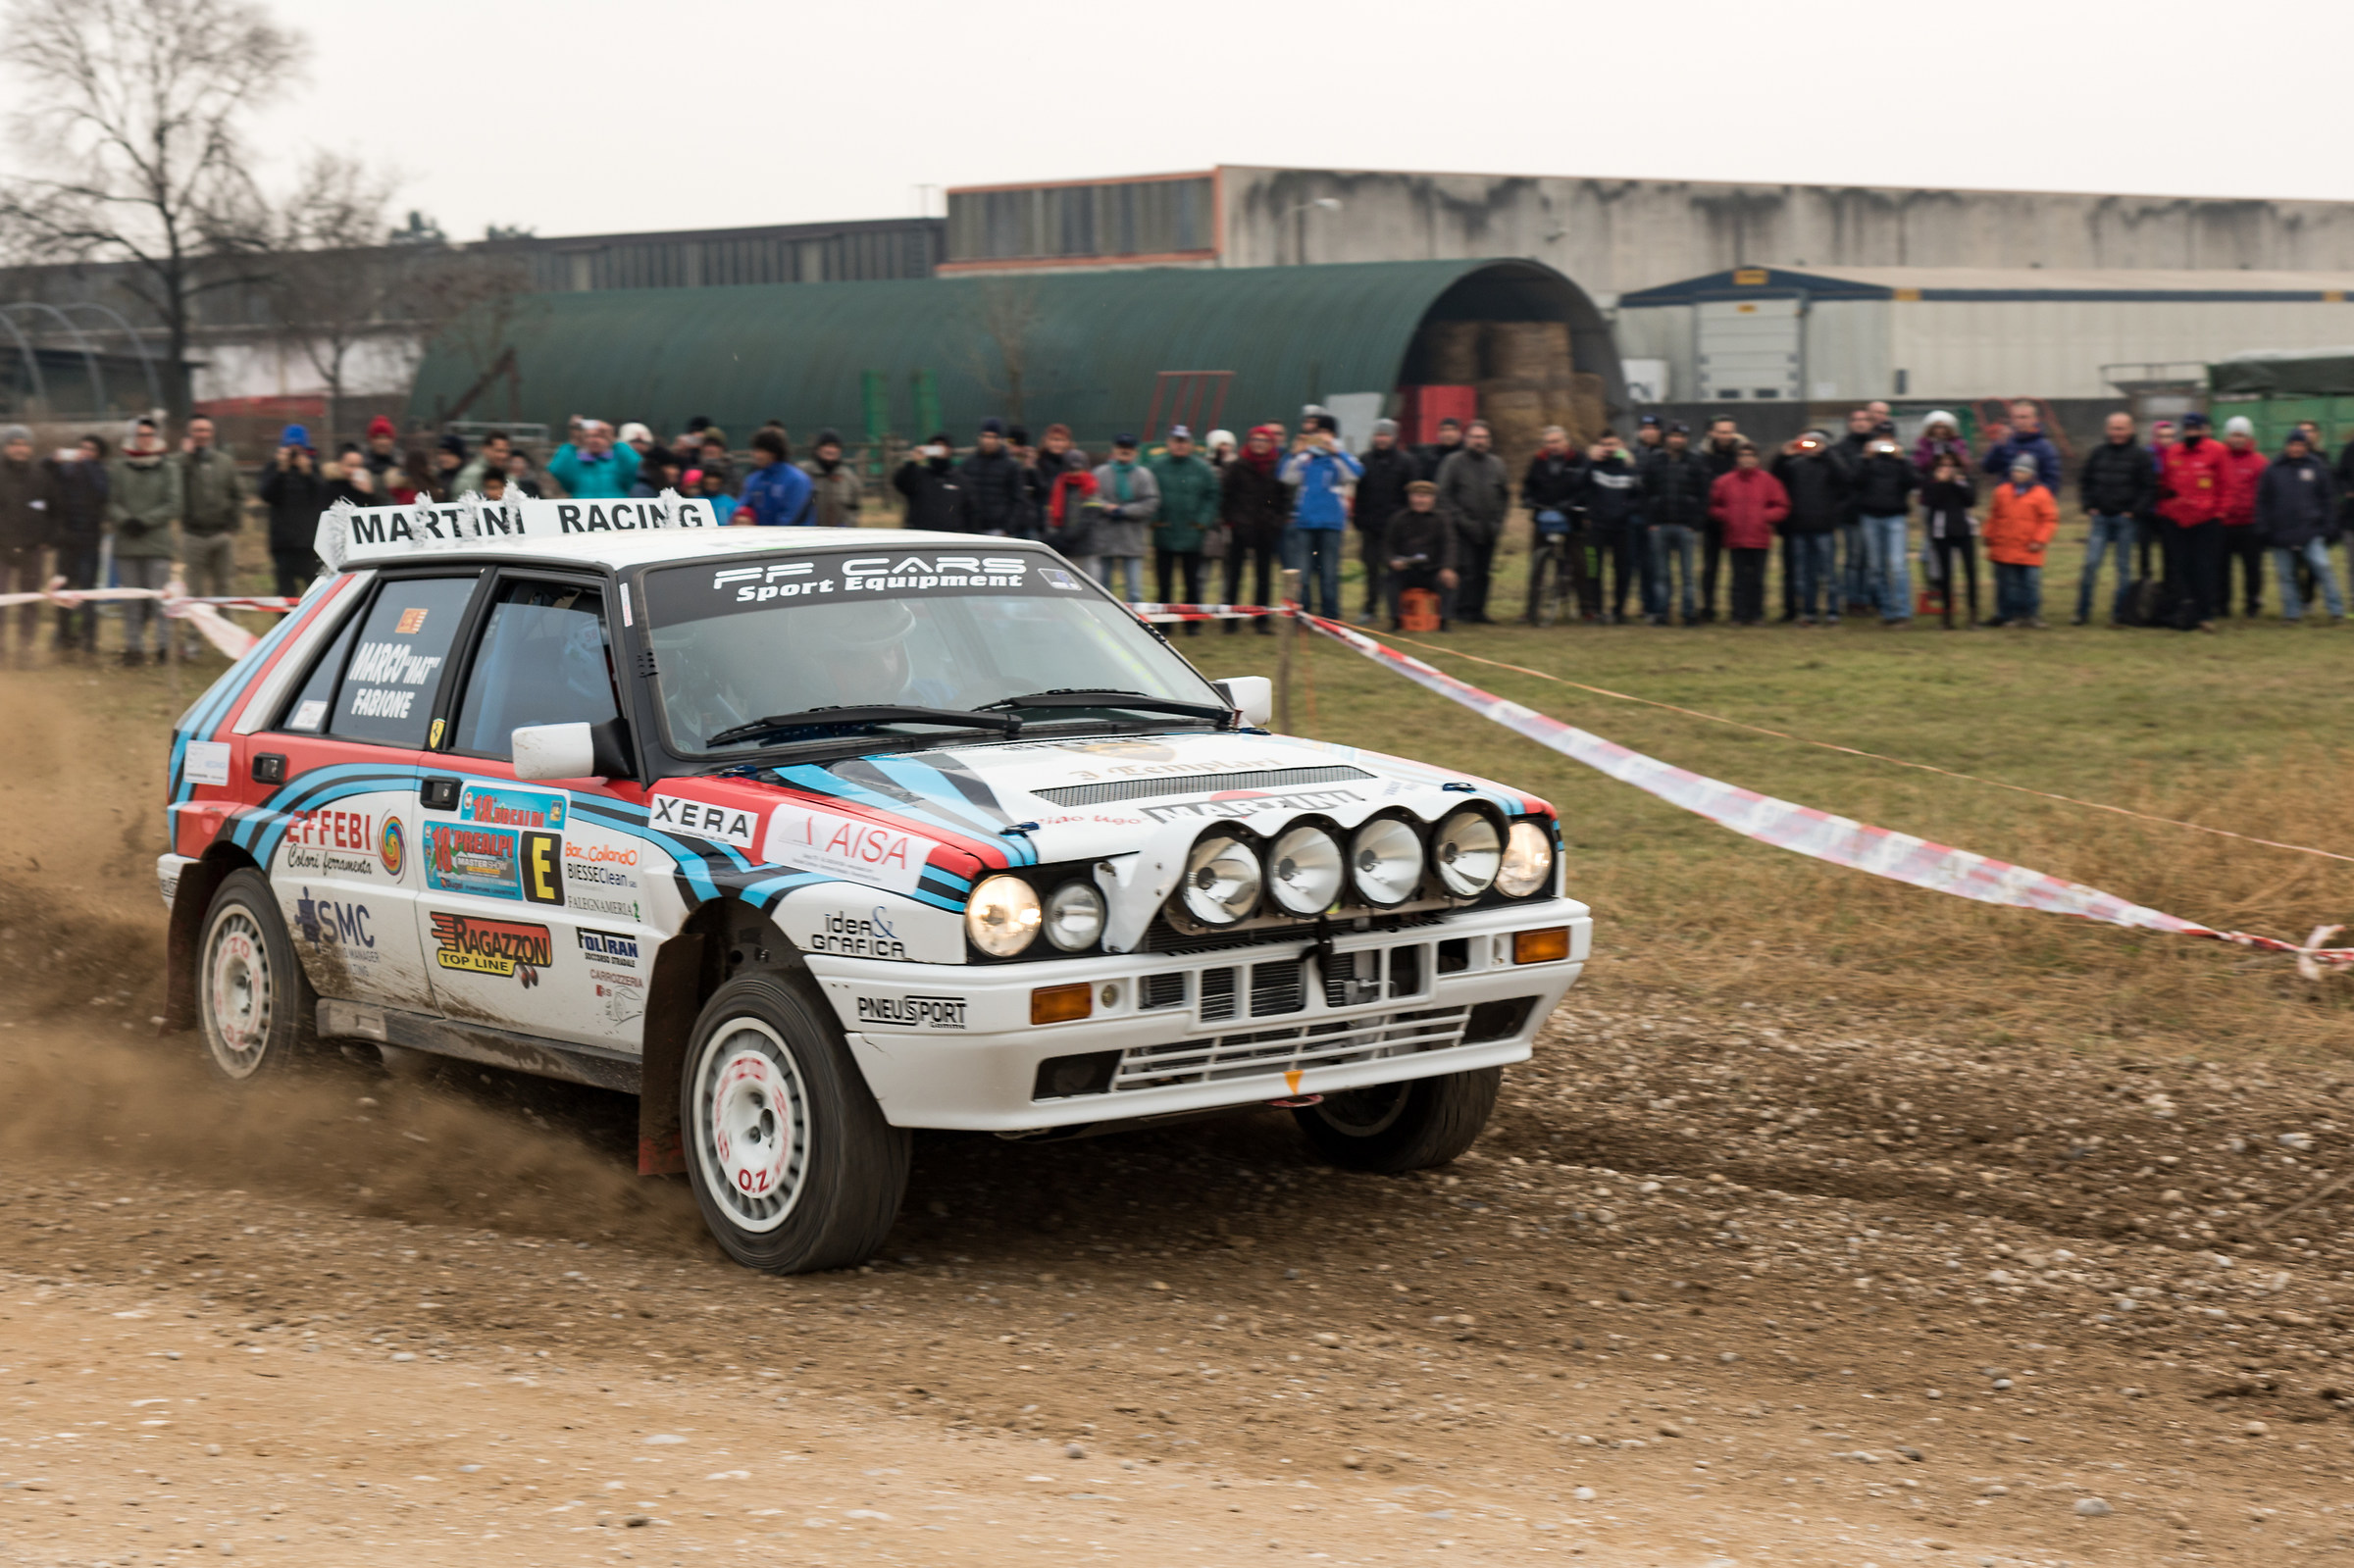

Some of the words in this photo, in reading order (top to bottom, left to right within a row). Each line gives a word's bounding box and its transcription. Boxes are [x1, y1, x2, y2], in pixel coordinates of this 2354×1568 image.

[351, 506, 526, 543] MARTINI
[557, 503, 703, 533] RACING
[713, 562, 814, 589] FF
[843, 556, 1026, 576] CARS
[737, 579, 835, 602] Sport
[844, 574, 1023, 591] Equipment
[351, 688, 416, 719] FABIONE
[654, 797, 749, 838] XERA
[1144, 790, 1362, 825] MARTINI
[286, 810, 372, 851] EFFEBI
[454, 830, 514, 859] PREALPI
[826, 822, 909, 871] AISA
[287, 842, 320, 869] Colori
[533, 836, 555, 900] E
[567, 895, 634, 918] FALEGNAMERIA
[319, 901, 375, 948] SMC
[453, 916, 549, 966] RAGAZZON
[576, 927, 640, 958] FOLTRAN
[441, 953, 470, 966] TOP
[475, 957, 509, 972] LINE
[589, 969, 644, 988] CARROZZERIA
[857, 995, 967, 1025] PNEUSPORT
